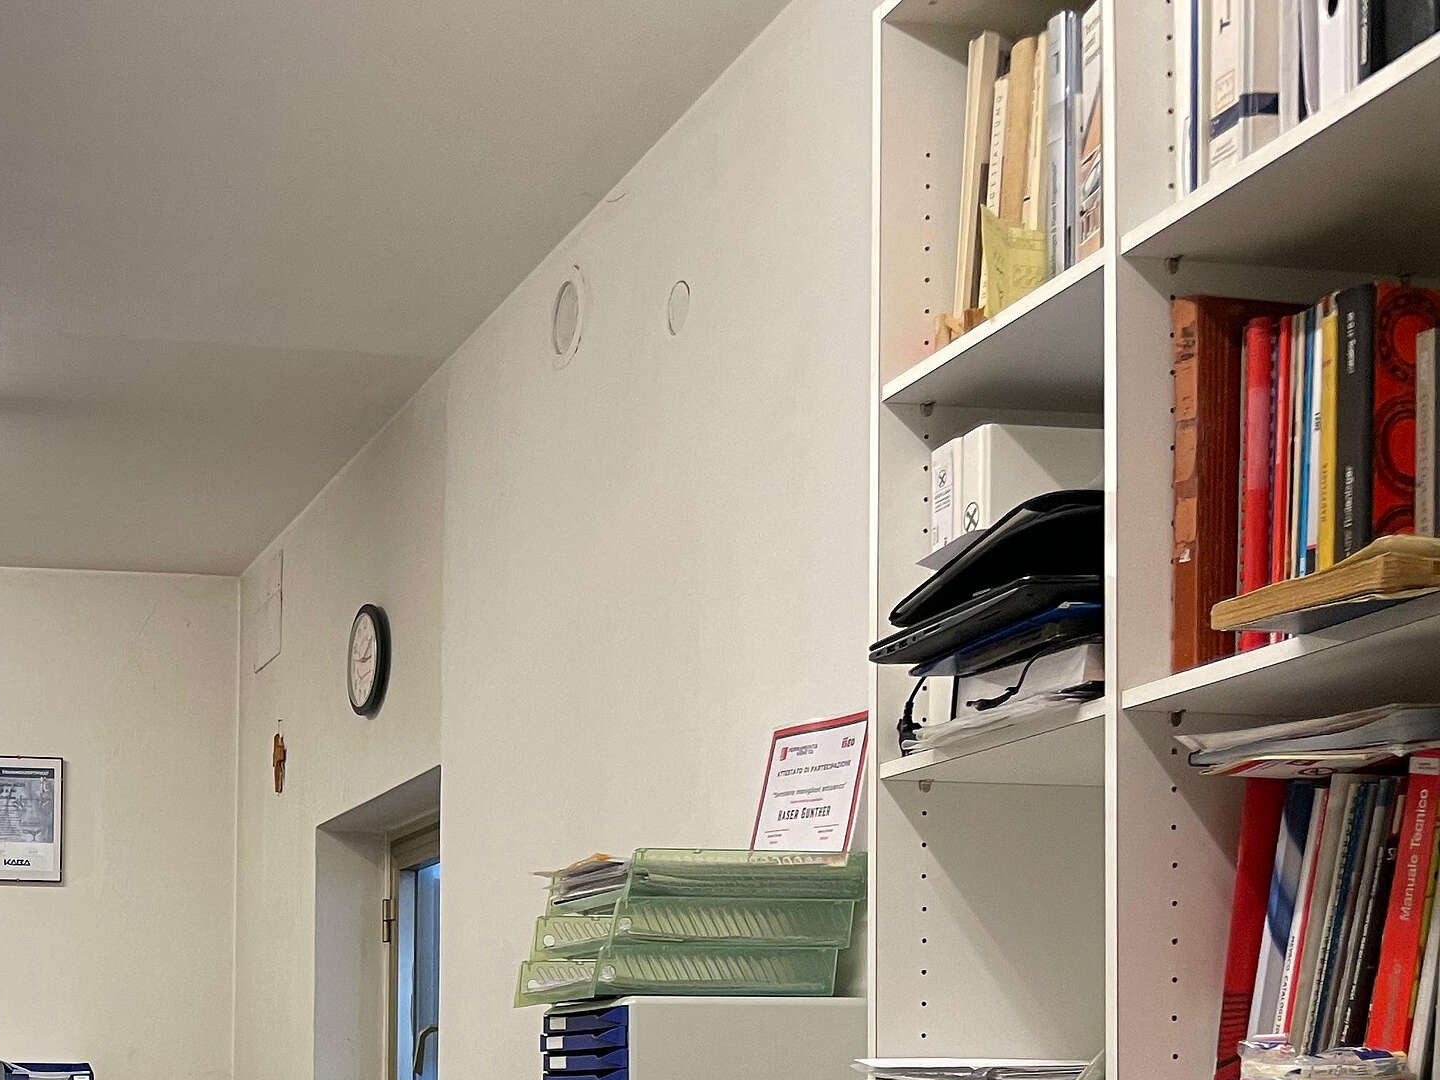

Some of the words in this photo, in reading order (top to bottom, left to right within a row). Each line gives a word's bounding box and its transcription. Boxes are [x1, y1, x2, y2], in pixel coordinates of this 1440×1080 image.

[3, 858, 31, 867] KABA
[1399, 854, 1419, 921] Manuale
[1409, 788, 1429, 850] Tecnico
[1277, 975, 1289, 1022] CATALOGO
